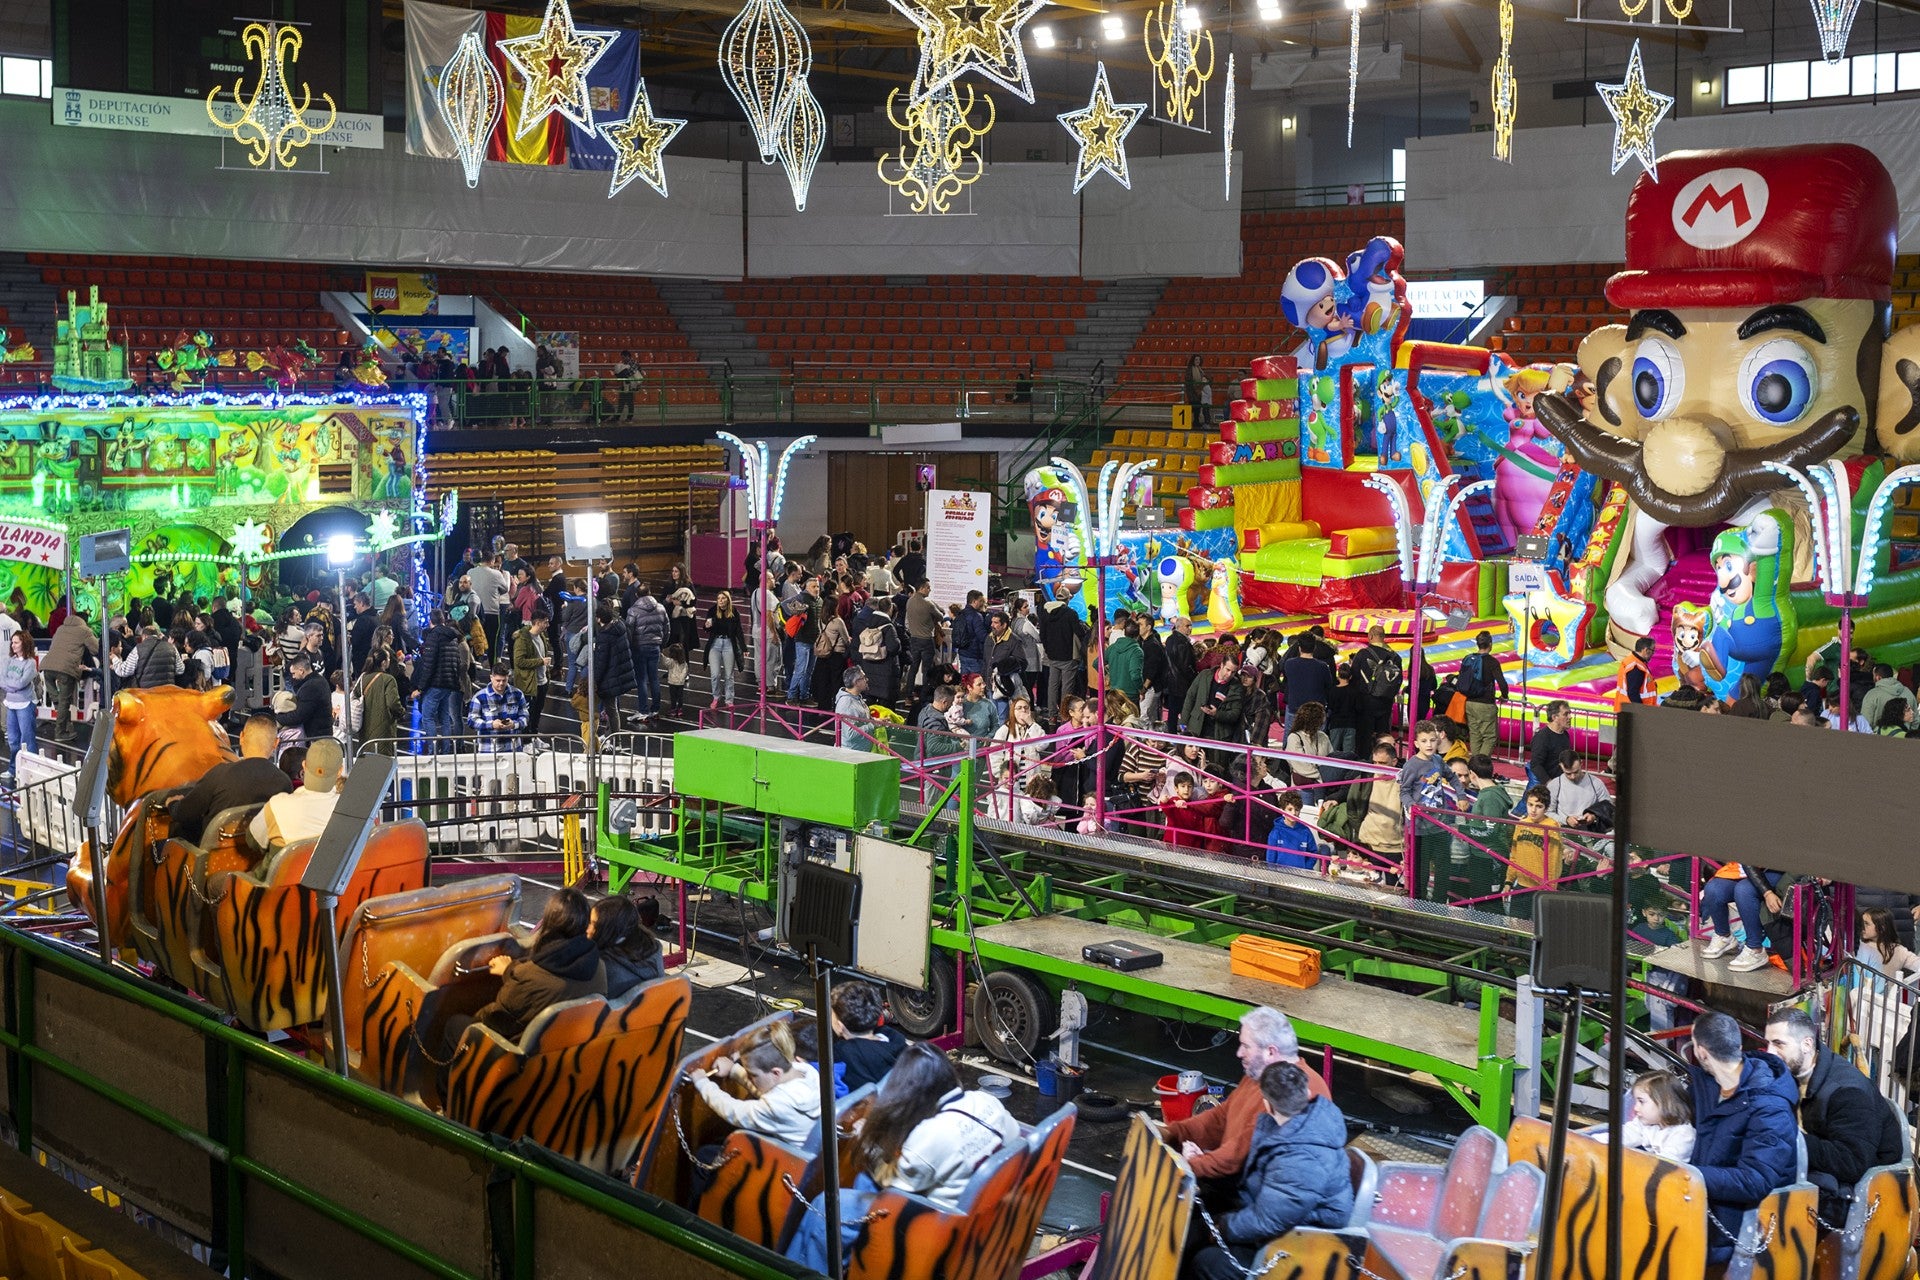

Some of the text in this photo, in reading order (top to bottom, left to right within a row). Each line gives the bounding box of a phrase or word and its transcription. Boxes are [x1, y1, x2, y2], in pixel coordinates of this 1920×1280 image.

[210, 63, 244, 73] MONDO
[88, 99, 171, 115] DEPUTACIÓN
[88, 113, 150, 127] OURENSE
[1682, 183, 1752, 228] M
[374, 288, 397, 299] LEGO
[1178, 409, 1185, 425] 1
[1231, 440, 1297, 462] MARIO
[1514, 573, 1538, 582] SAÍDA
